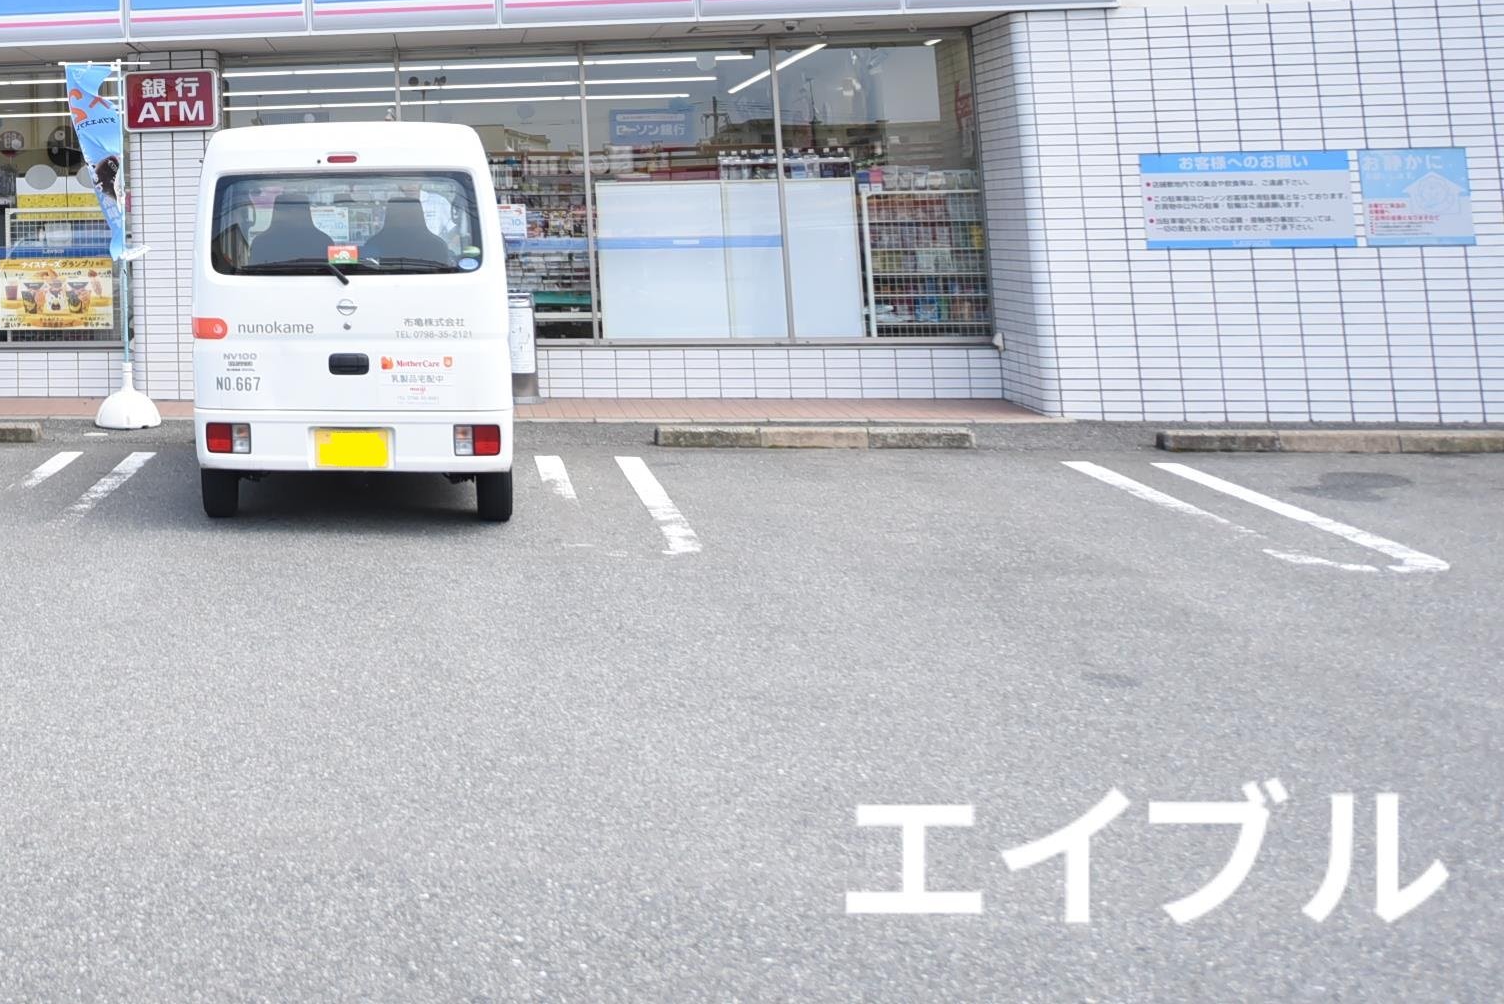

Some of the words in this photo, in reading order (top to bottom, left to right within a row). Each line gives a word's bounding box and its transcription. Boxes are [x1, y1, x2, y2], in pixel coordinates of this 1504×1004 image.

[141, 77, 199, 98] 銀行
[137, 100, 205, 123] ATM
[616, 123, 685, 136] ローソン銀行
[1178, 155, 1309, 170] お客様へのお願い
[238, 321, 314, 334] nunokame
[396, 330, 410, 339] TEL
[216, 376, 261, 392] NO.667
